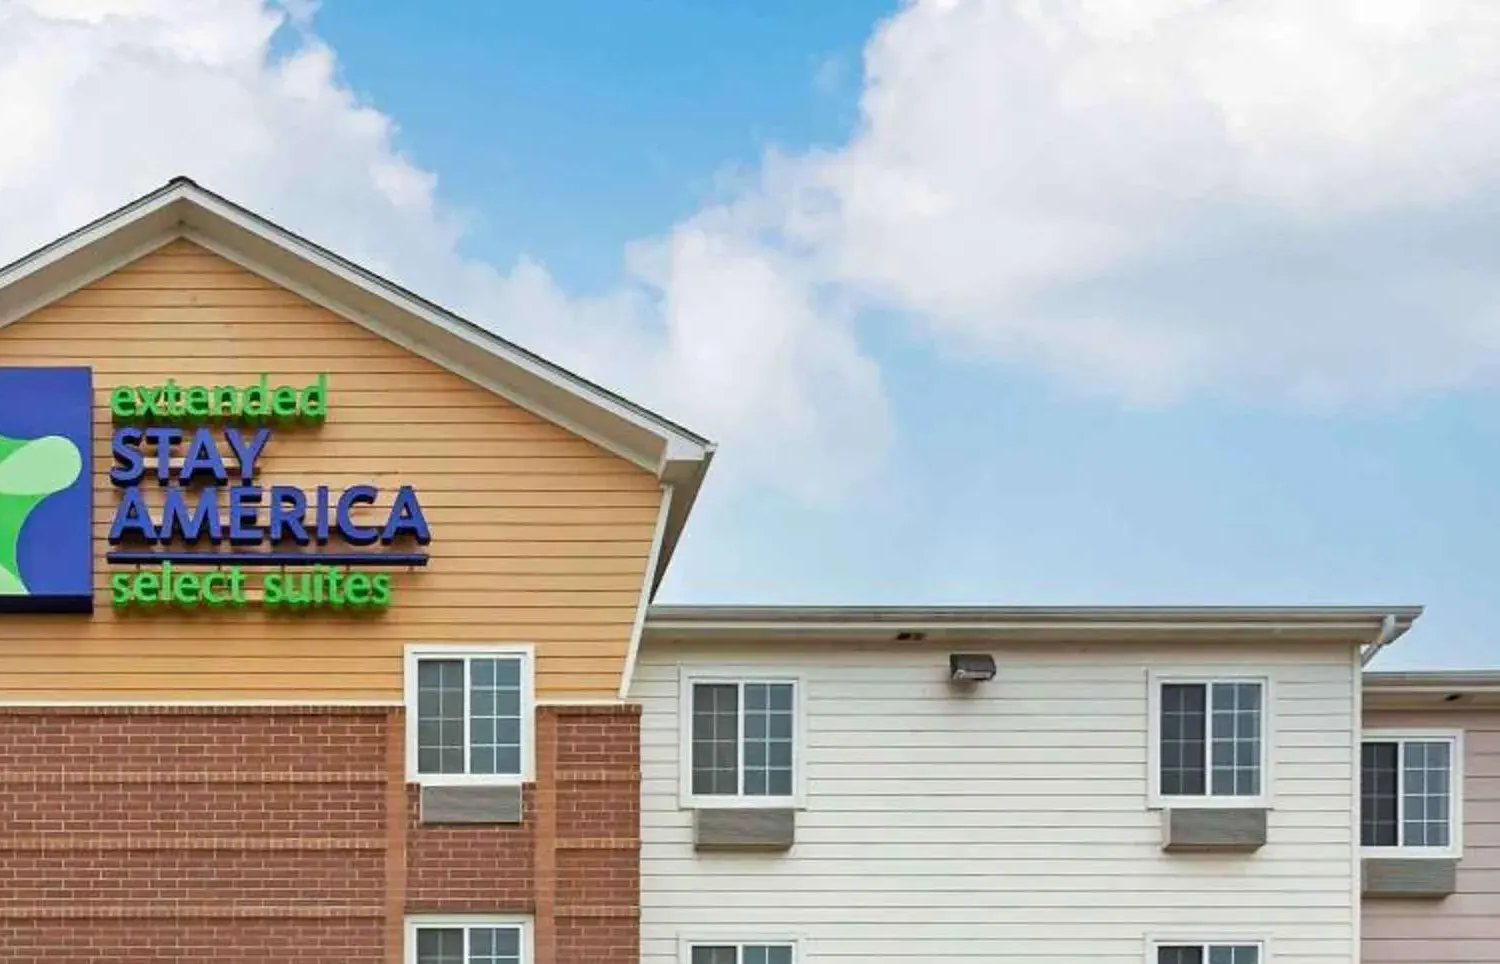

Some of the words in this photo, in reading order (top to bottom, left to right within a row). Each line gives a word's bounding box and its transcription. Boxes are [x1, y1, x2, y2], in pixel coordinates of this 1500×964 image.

[111, 373, 328, 421] extended
[110, 427, 271, 485] STAY
[108, 484, 431, 545] AMERICA
[111, 561, 246, 607] select
[263, 564, 390, 607] suites
